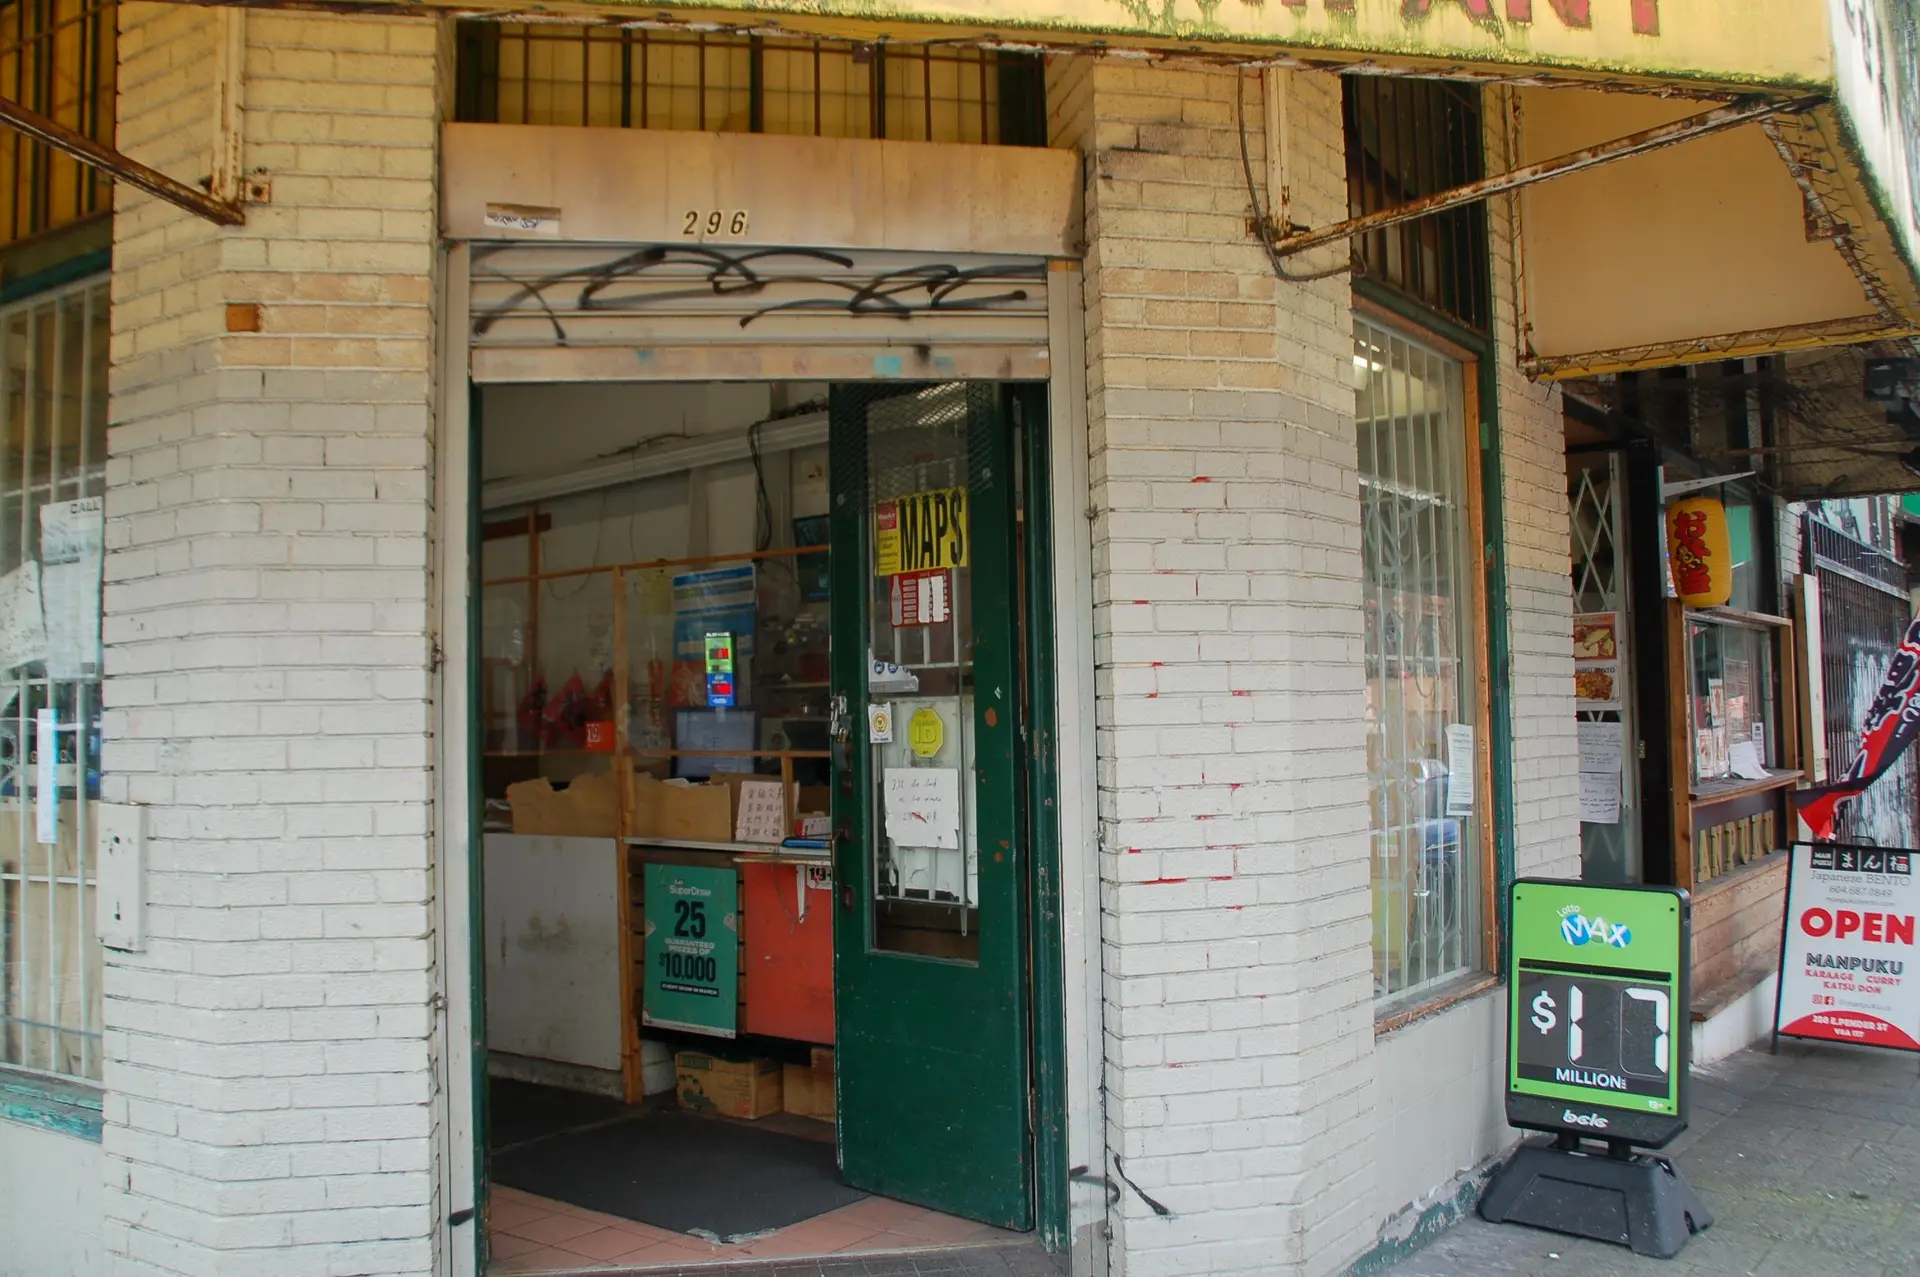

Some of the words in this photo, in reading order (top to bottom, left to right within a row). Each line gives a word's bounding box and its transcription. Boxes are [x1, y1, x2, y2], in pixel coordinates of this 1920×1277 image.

[683, 210, 747, 236] 296
[900, 489, 963, 572] MAPS
[1841, 852, 1909, 872] まん福
[1811, 870, 1863, 884] Japanese
[1866, 874, 1911, 887] BENTO
[674, 899, 706, 939] 25
[1556, 904, 1581, 917] Lotto
[1560, 914, 1628, 948] MAX
[1800, 907, 1915, 946] OPEN
[664, 937, 715, 949] GUARANTEED
[659, 952, 716, 982] $10,000
[1806, 952, 1903, 976] MANPUKU
[1805, 969, 1854, 981] KARAAGE
[1866, 975, 1902, 986] CURRY
[1823, 982, 1855, 991] KATSU
[1556, 1067, 1622, 1090] MILLION
